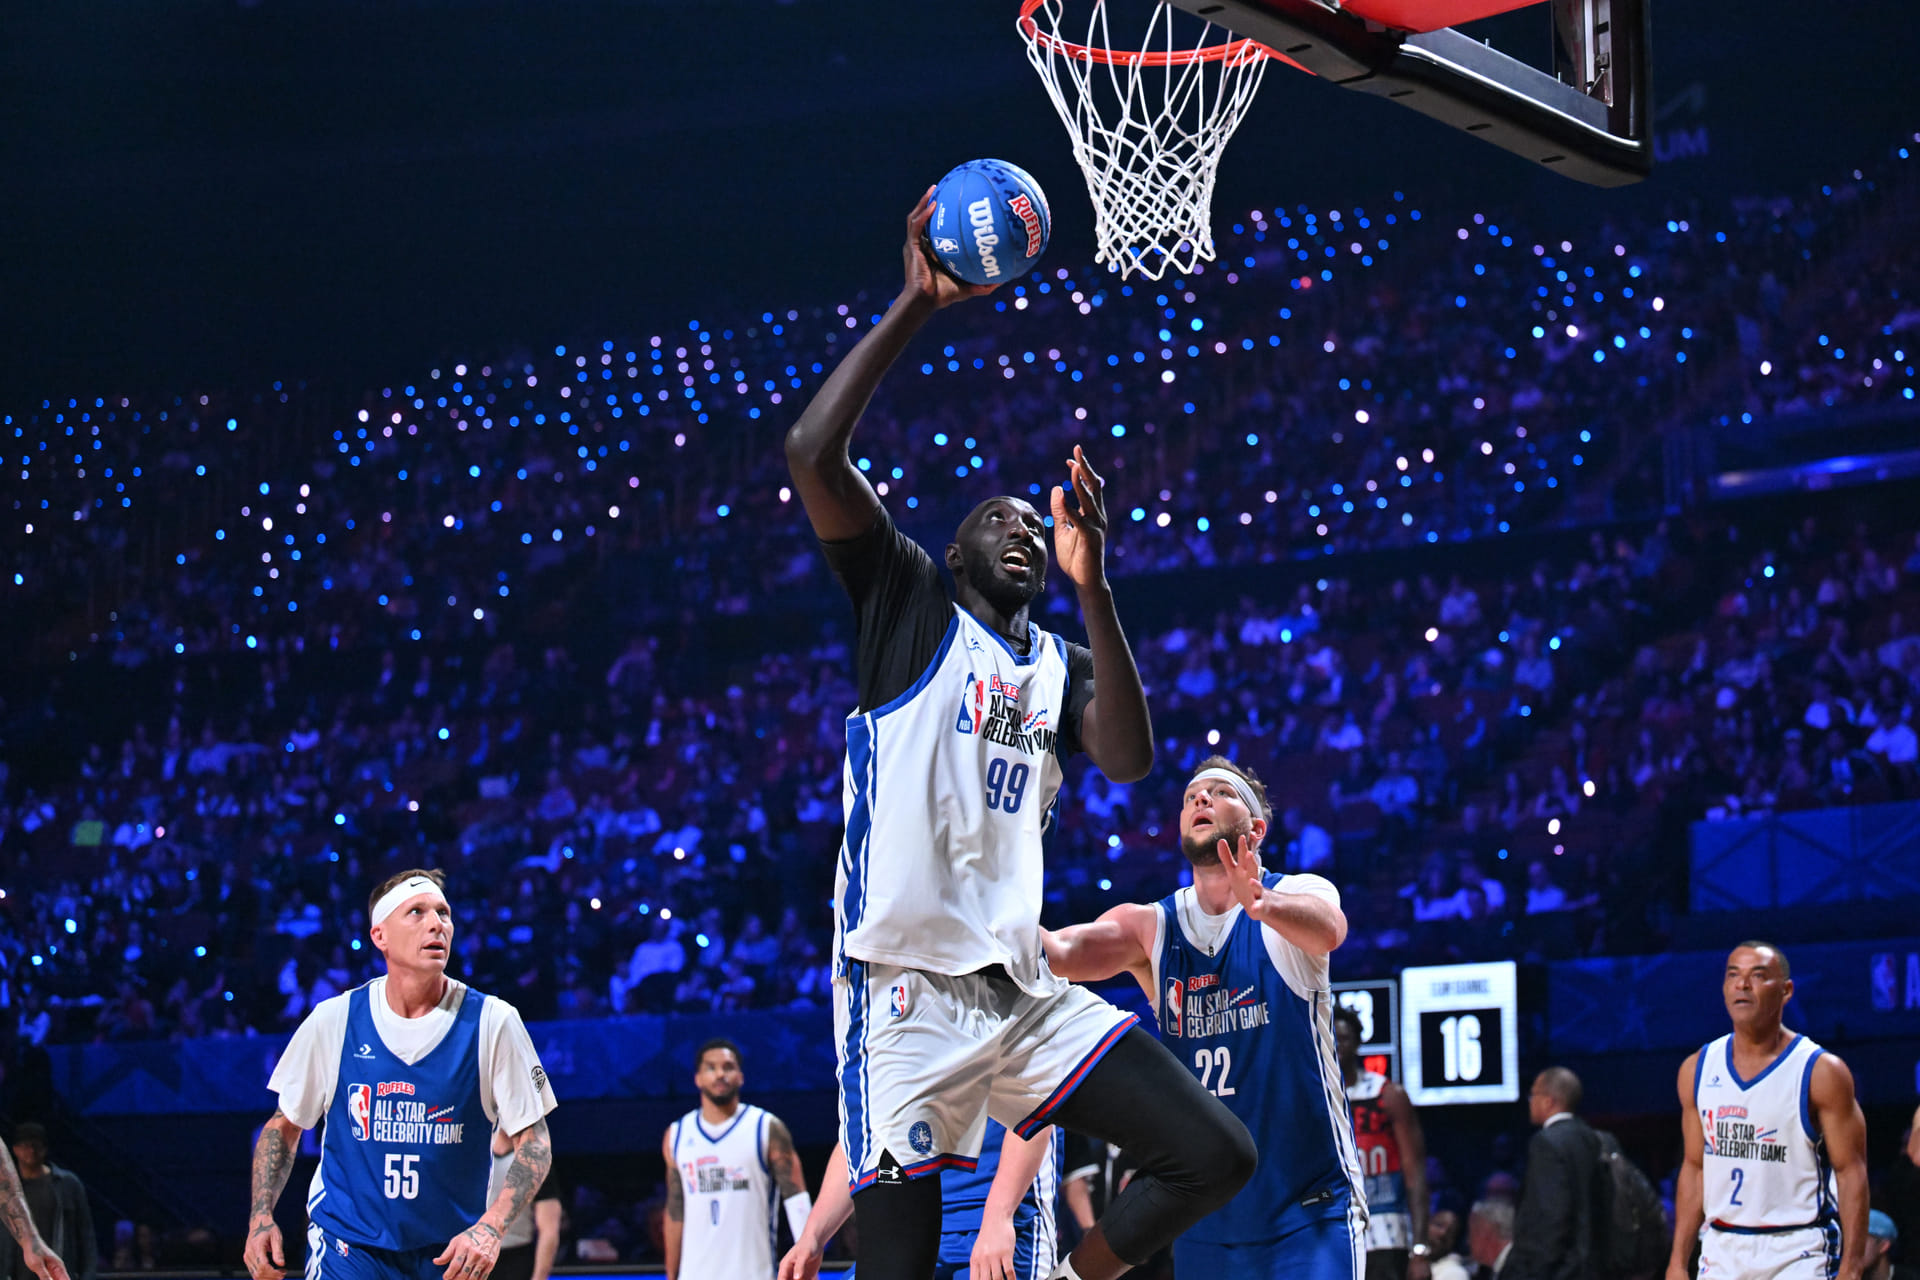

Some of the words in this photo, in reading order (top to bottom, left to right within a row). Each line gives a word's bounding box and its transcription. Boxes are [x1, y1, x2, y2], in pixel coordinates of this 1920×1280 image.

[968, 197, 1001, 278] Wilson
[1007, 193, 1041, 258] RUFFLES
[990, 674, 1021, 701] RFLES
[983, 716, 1034, 755] CELEBITY
[986, 758, 1029, 814] 99
[1239, 1001, 1270, 1030] GAME
[1440, 1015, 1482, 1081] 16
[377, 1082, 415, 1096] RUFFLES
[1195, 1046, 1235, 1096] 22
[374, 1100, 393, 1121] ALL
[396, 1101, 426, 1122] STAR
[373, 1120, 433, 1144] CELEBRITY
[434, 1123, 464, 1144] GAME
[1732, 1122, 1755, 1142] STAR
[1760, 1143, 1787, 1163] GAME
[384, 1153, 420, 1200] 55
[1730, 1168, 1743, 1206] 2
